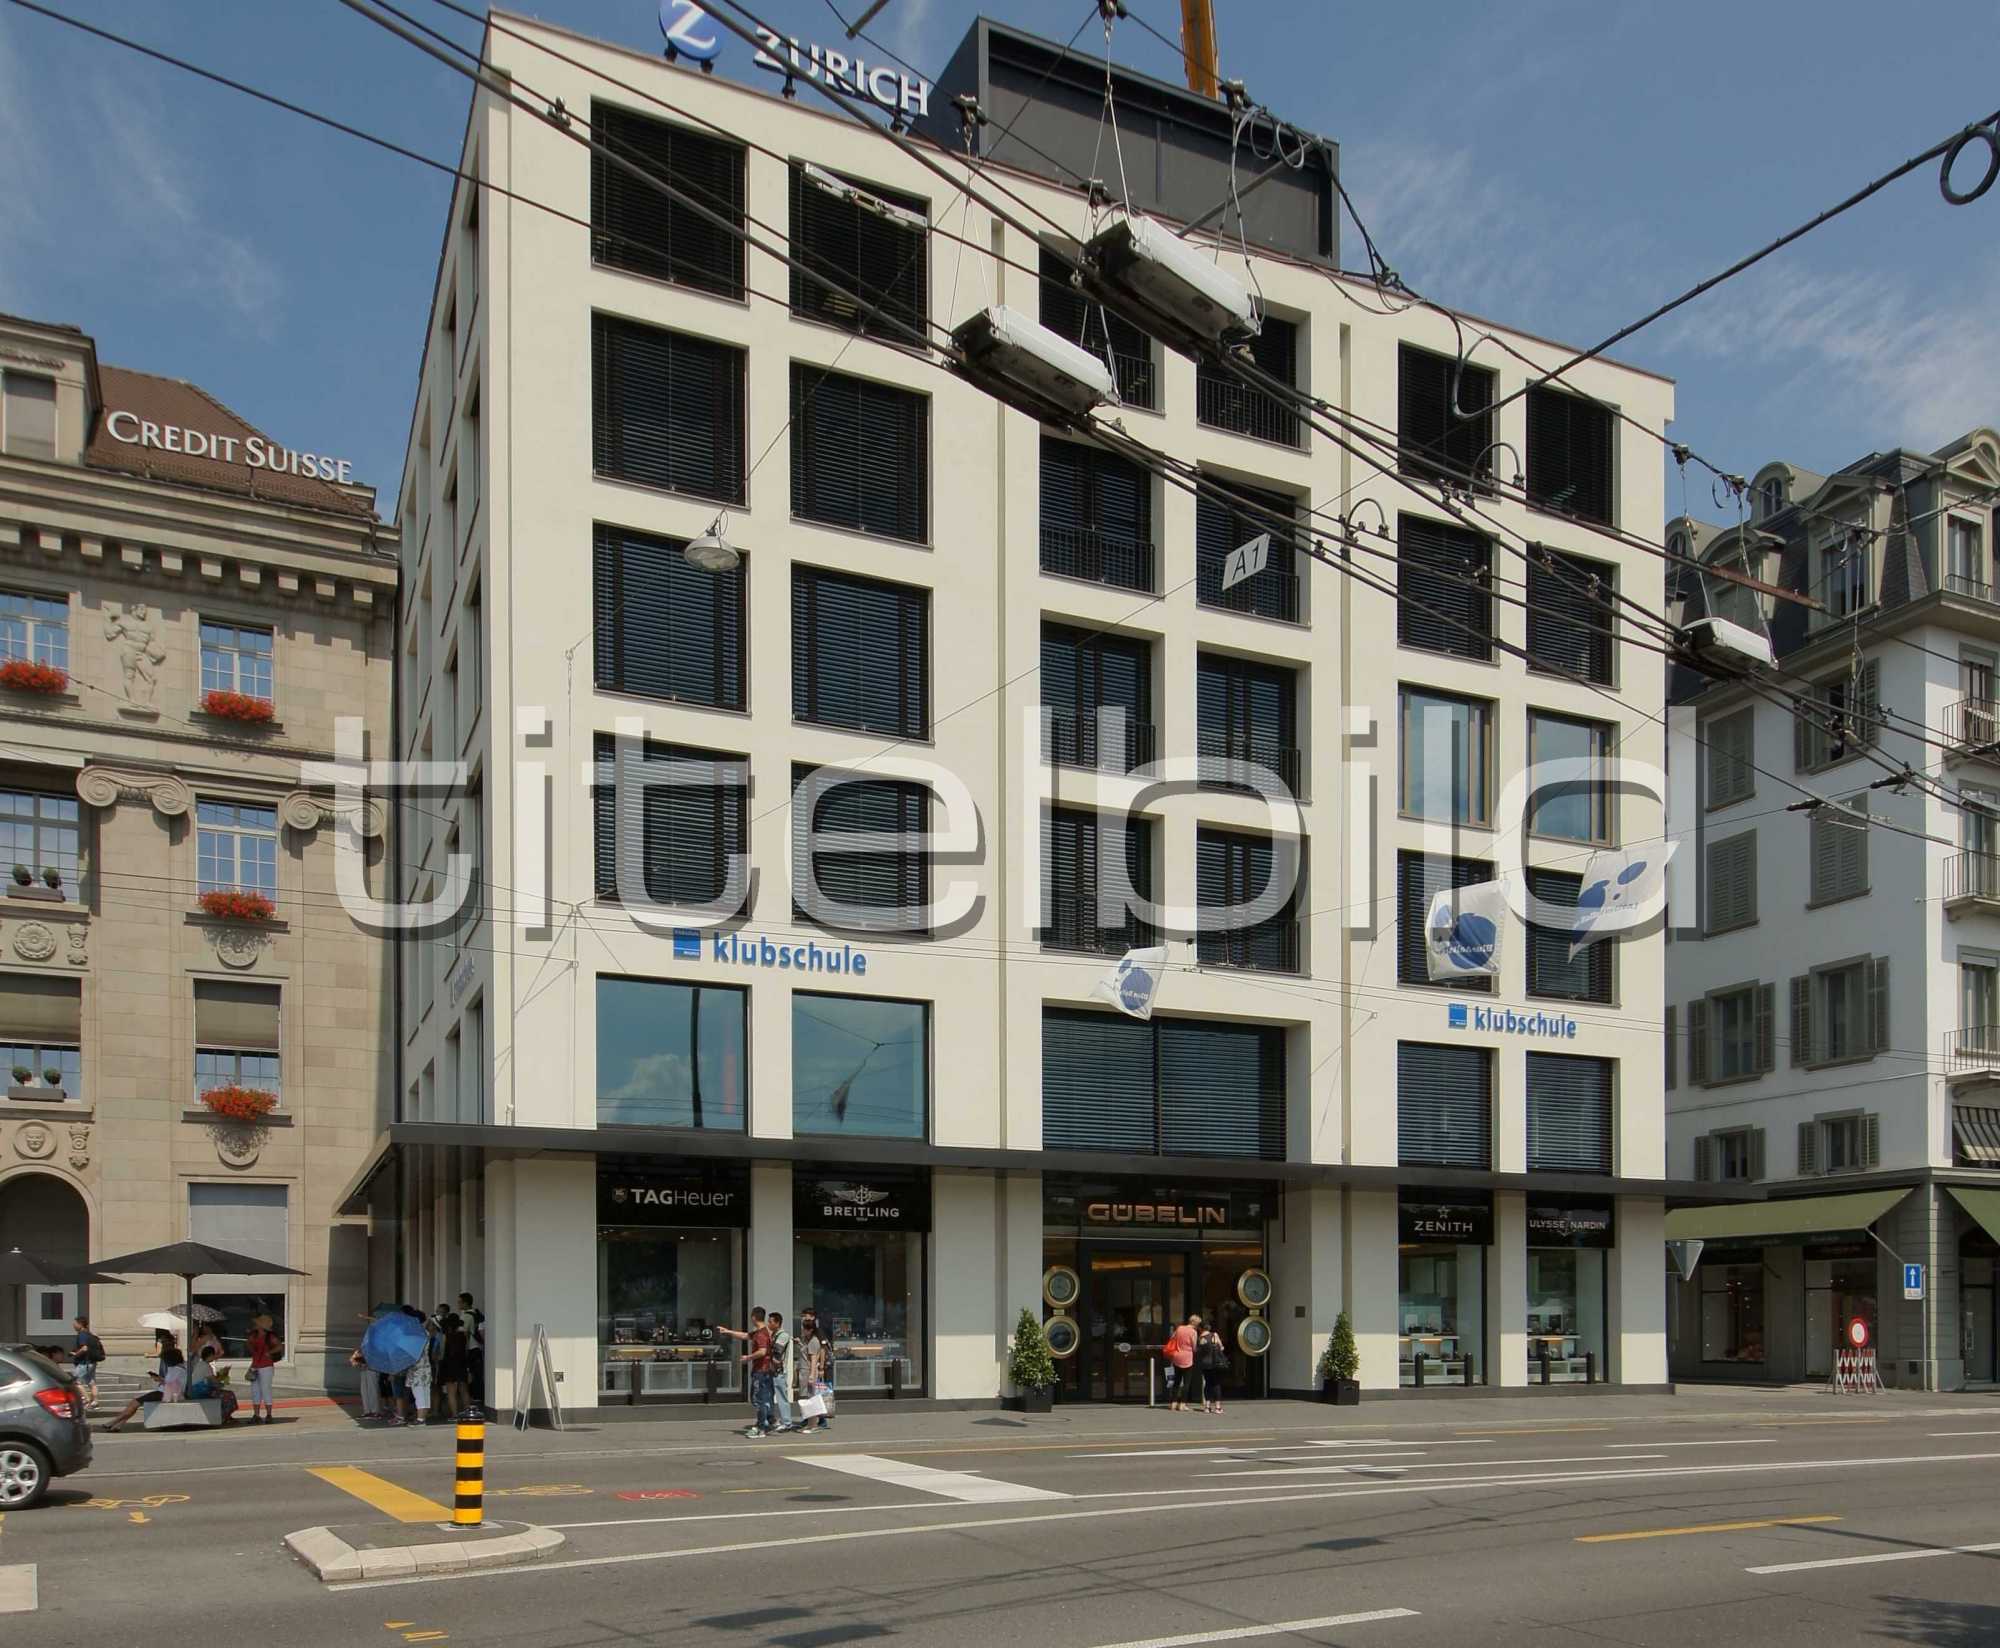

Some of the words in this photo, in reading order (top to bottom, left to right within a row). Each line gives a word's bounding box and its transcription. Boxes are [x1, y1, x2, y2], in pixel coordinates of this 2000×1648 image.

[106, 411, 240, 462] CREDIT
[245, 437, 354, 485] SUISSE
[1232, 542, 1260, 580] A1
[713, 931, 867, 975] klubschule
[1475, 1006, 1577, 1039] klubschule
[823, 1206, 900, 1217] BREITLING
[1087, 1203, 1225, 1223] GÜBELIN
[1529, 1219, 1566, 1229] ULYSSE
[1570, 1221, 1606, 1230] NARDIN
[1414, 1220, 1473, 1232] ZENITH
